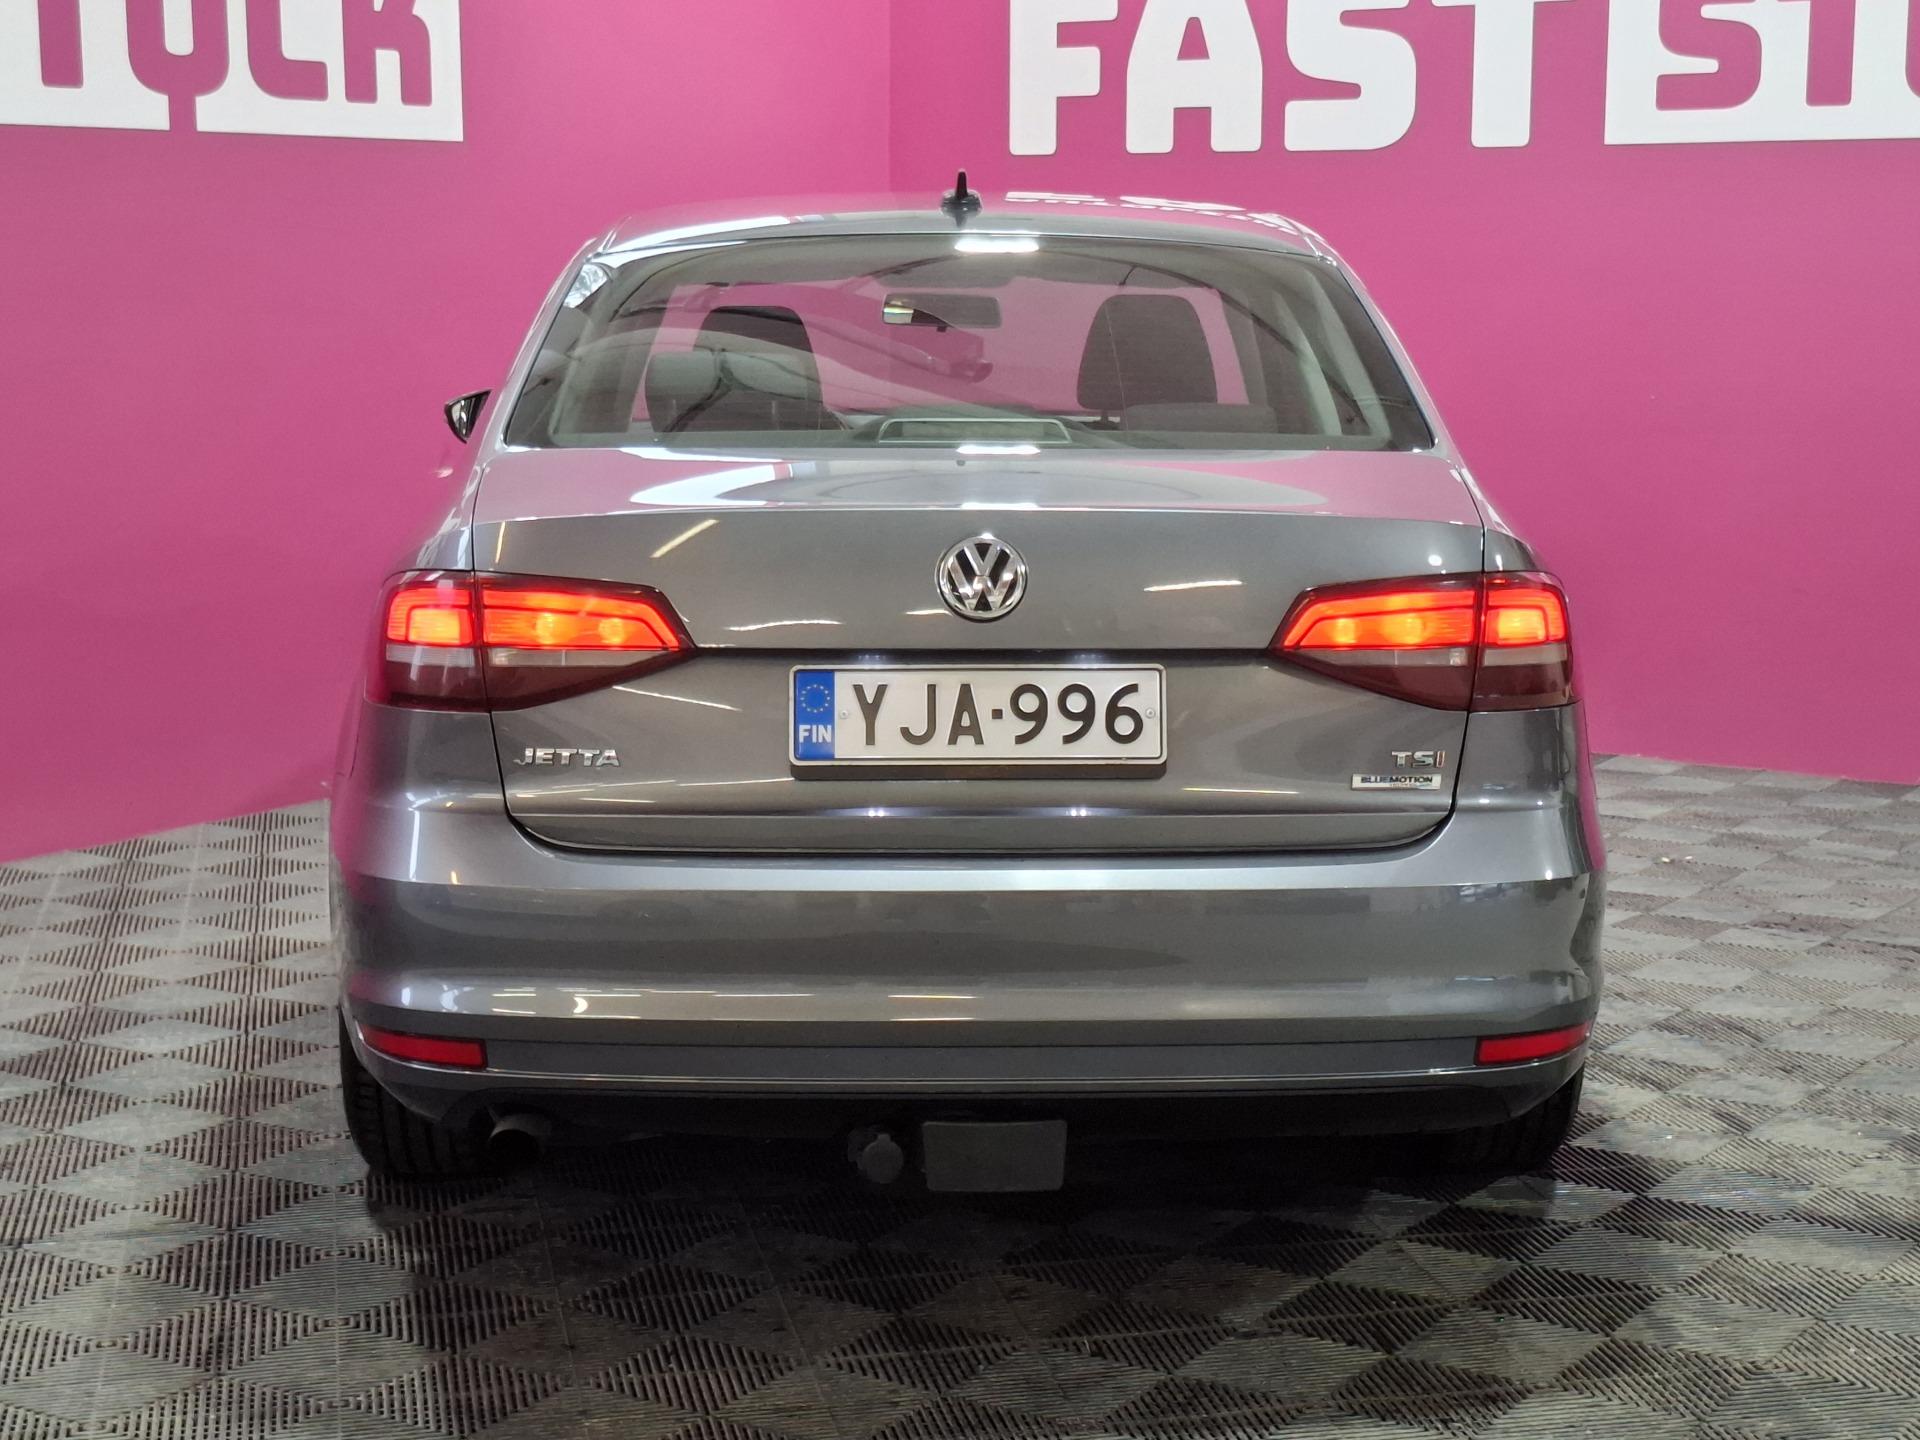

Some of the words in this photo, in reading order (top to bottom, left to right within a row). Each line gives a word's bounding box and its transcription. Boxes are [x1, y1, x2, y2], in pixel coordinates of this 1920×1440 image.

[1008, 0, 1576, 156] FAST
[798, 723, 833, 744] FIN
[513, 747, 621, 768] JETTA
[1391, 750, 1446, 769] TSI
